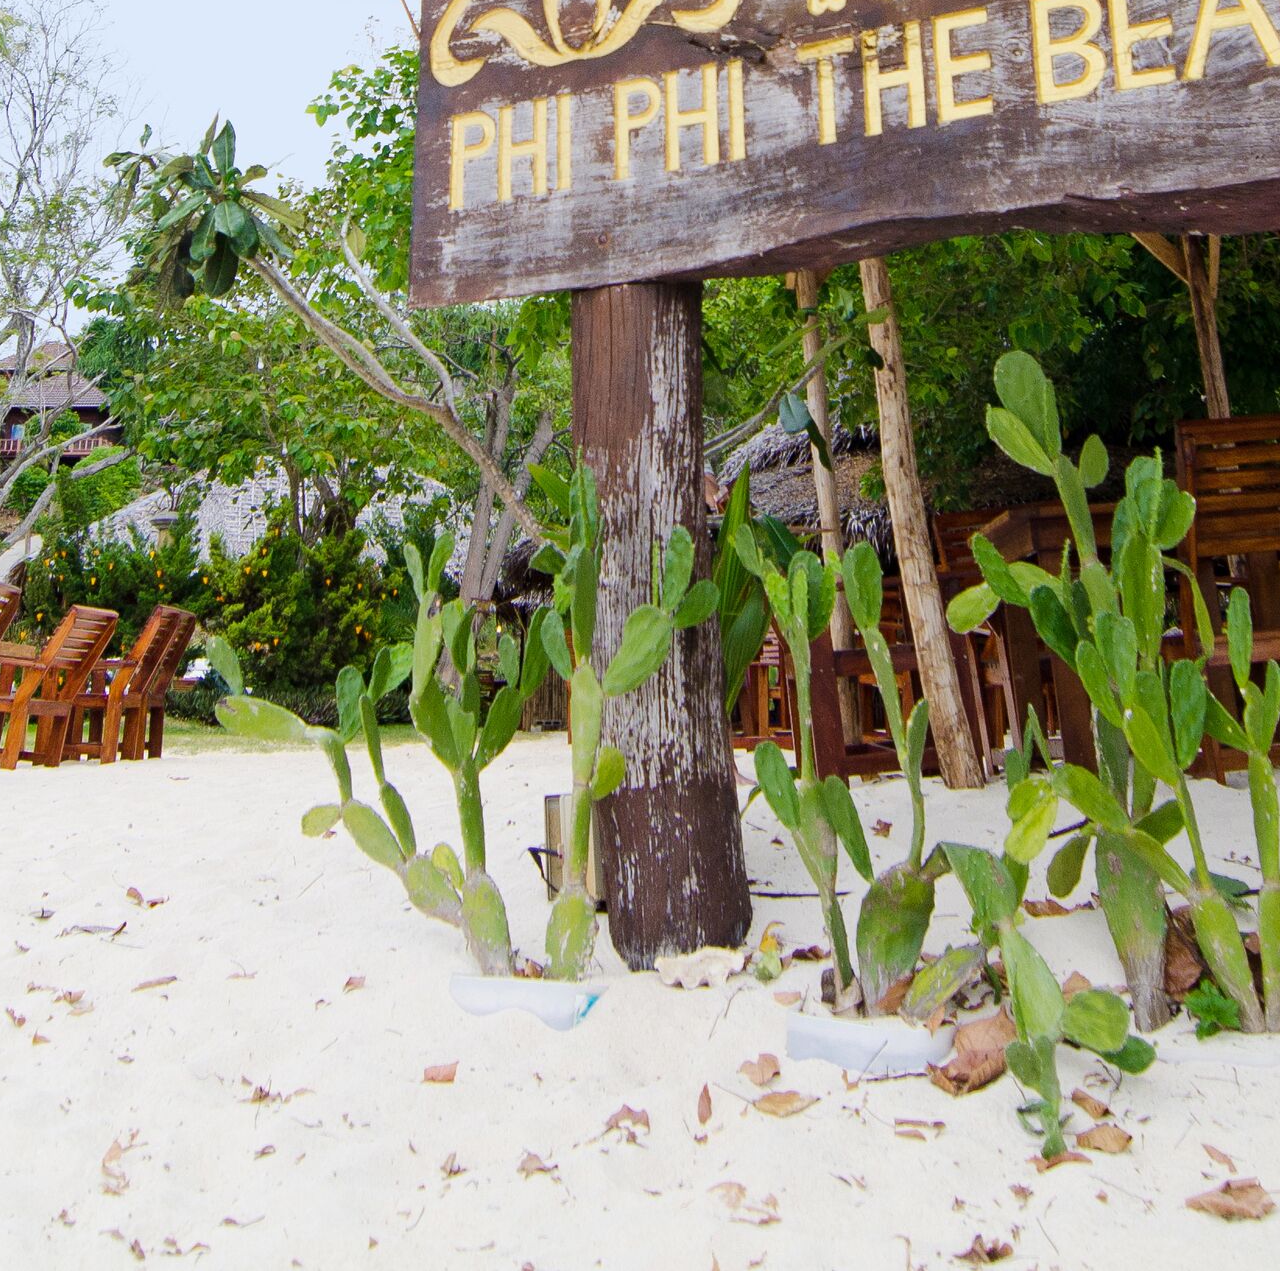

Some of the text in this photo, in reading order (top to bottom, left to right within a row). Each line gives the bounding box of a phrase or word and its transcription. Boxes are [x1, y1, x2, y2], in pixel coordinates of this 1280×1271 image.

[448, 93, 573, 211] PHI
[613, 59, 748, 181] PHI
[795, 6, 995, 146] THE
